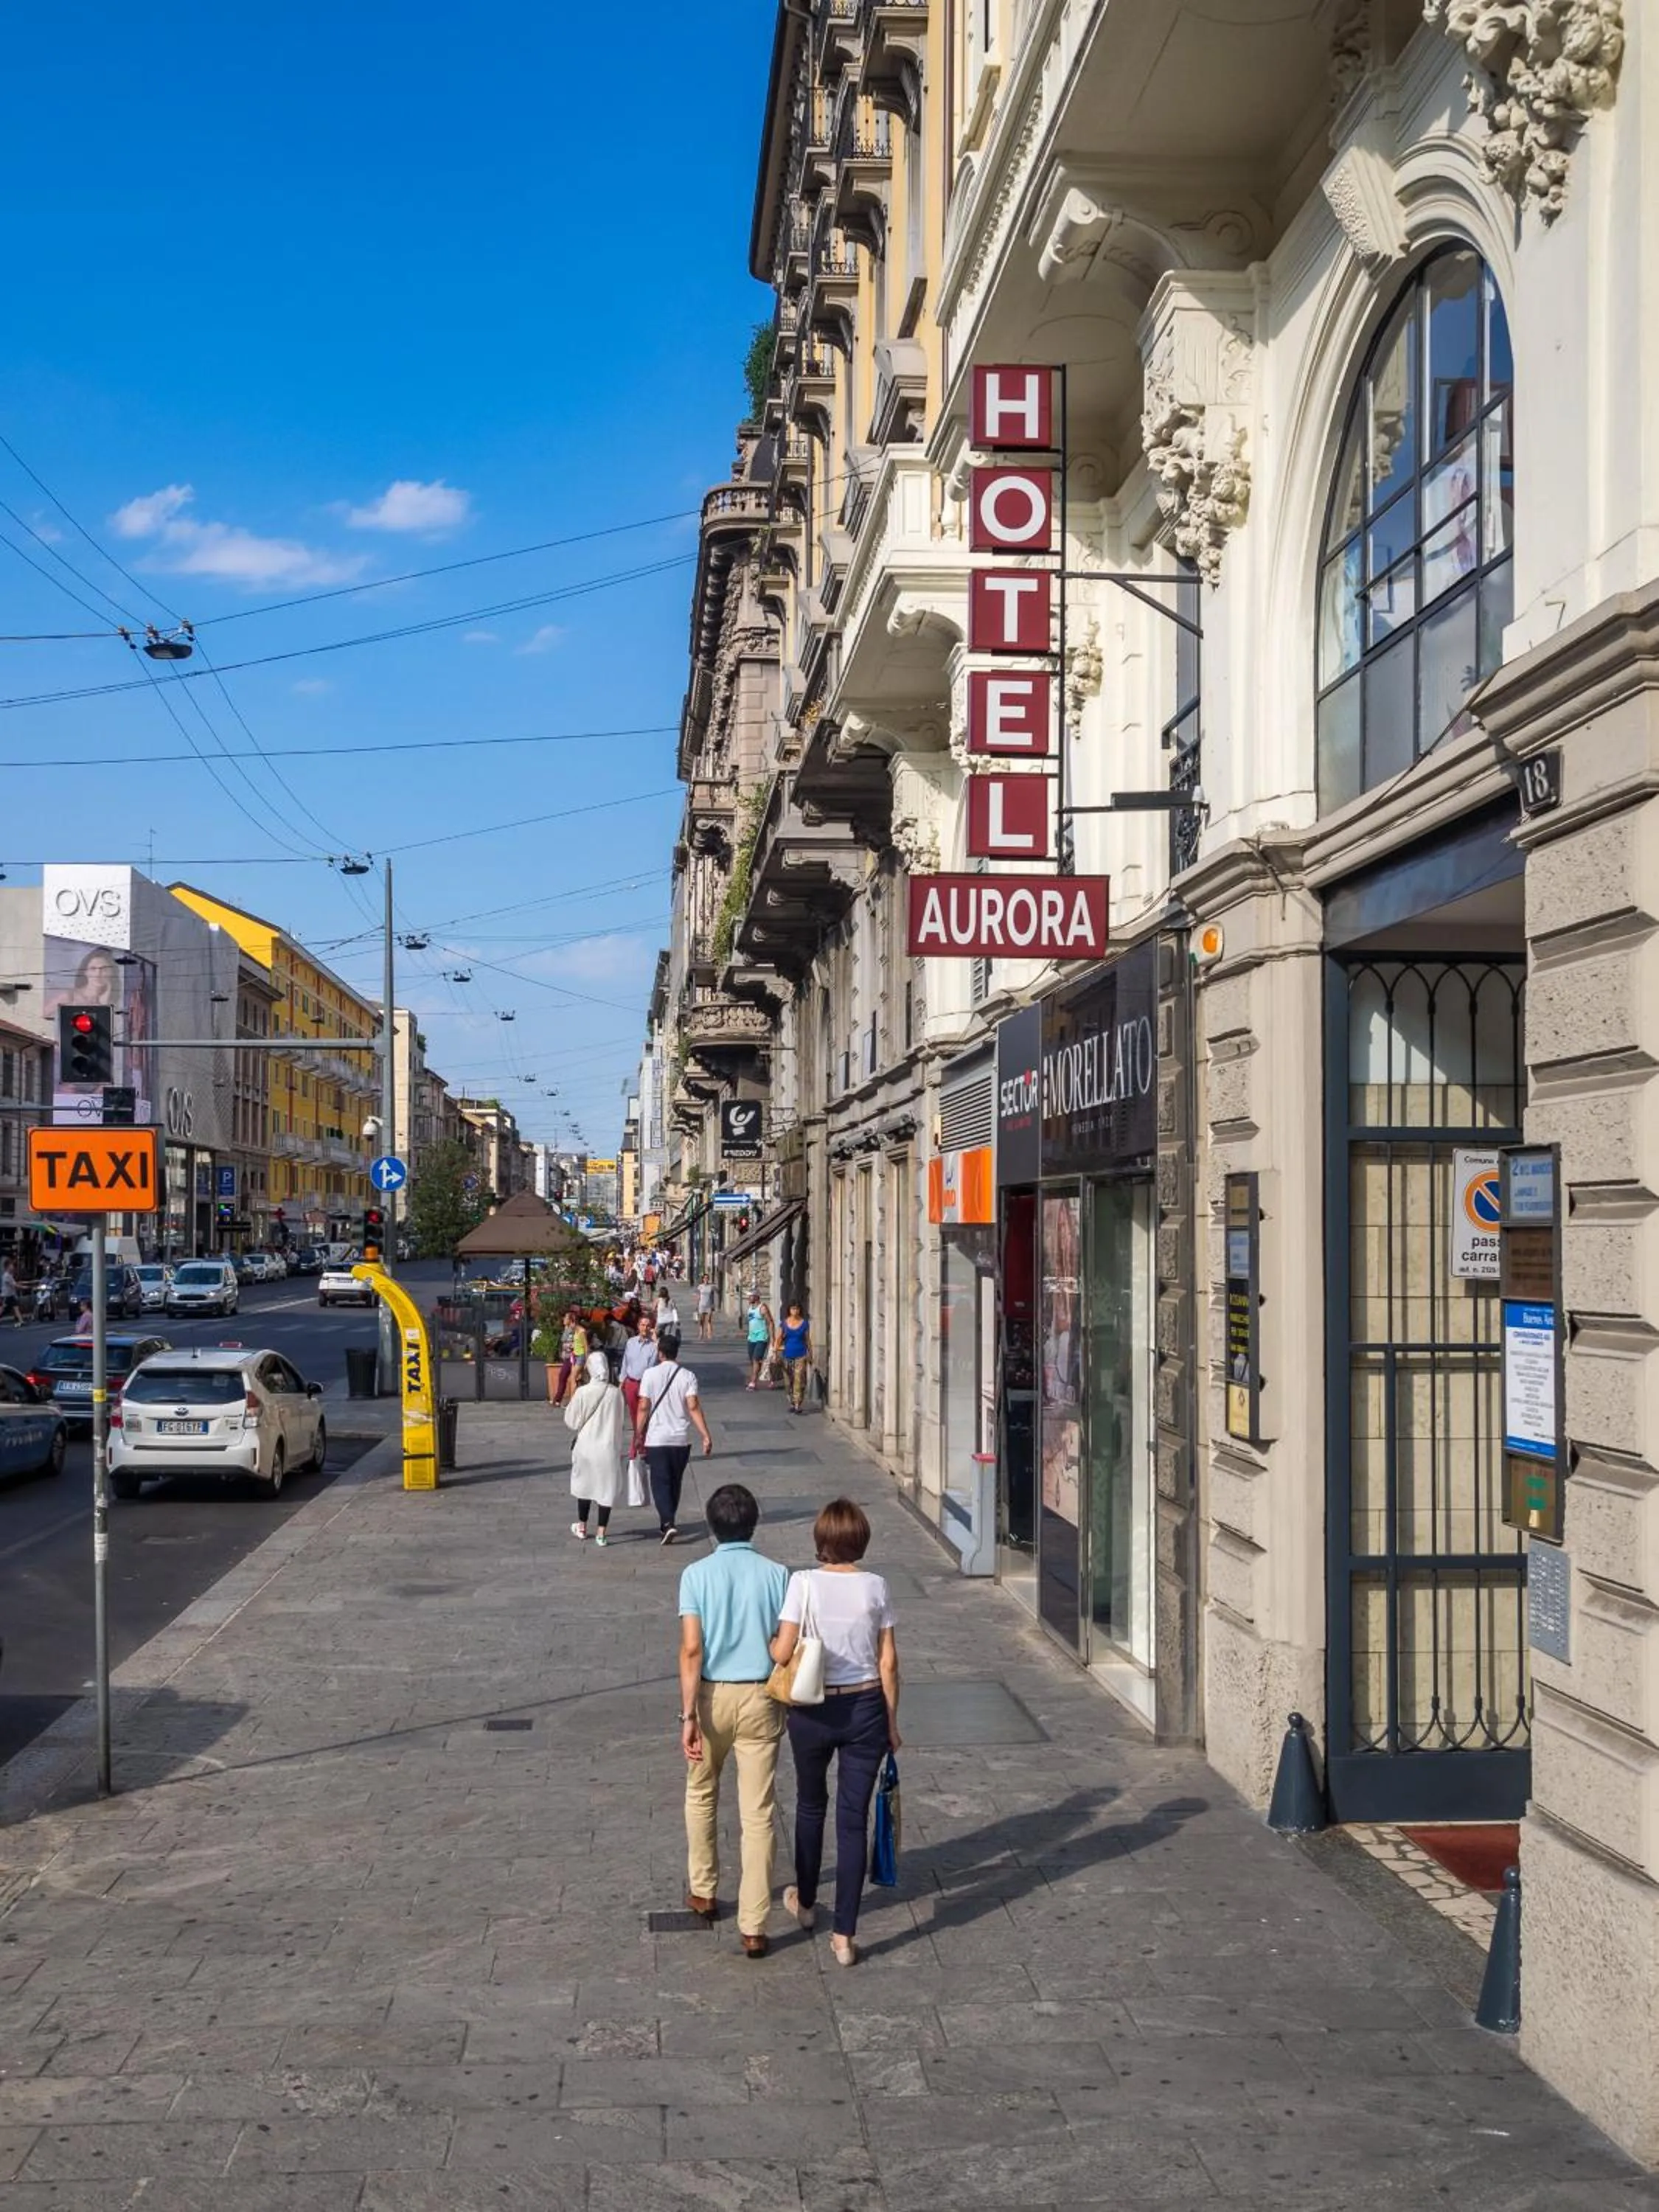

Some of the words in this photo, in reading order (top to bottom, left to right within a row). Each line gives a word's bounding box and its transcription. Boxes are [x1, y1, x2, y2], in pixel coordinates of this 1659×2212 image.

[979, 372, 1047, 848] HOTEL
[1524, 759, 1549, 803] 18
[55, 888, 122, 919] OVS
[917, 887, 1096, 947] AURORA
[1048, 1015, 1153, 1119] MORELLATO
[168, 1087, 194, 1138] OVS
[1000, 1067, 1039, 1118] SECTOR
[35, 1151, 149, 1189] TAXI
[723, 1149, 758, 1157] FREDDY
[1464, 1156, 1495, 1165] Comune
[1461, 1251, 1500, 1262] carra
[406, 1341, 421, 1394] TAXI
